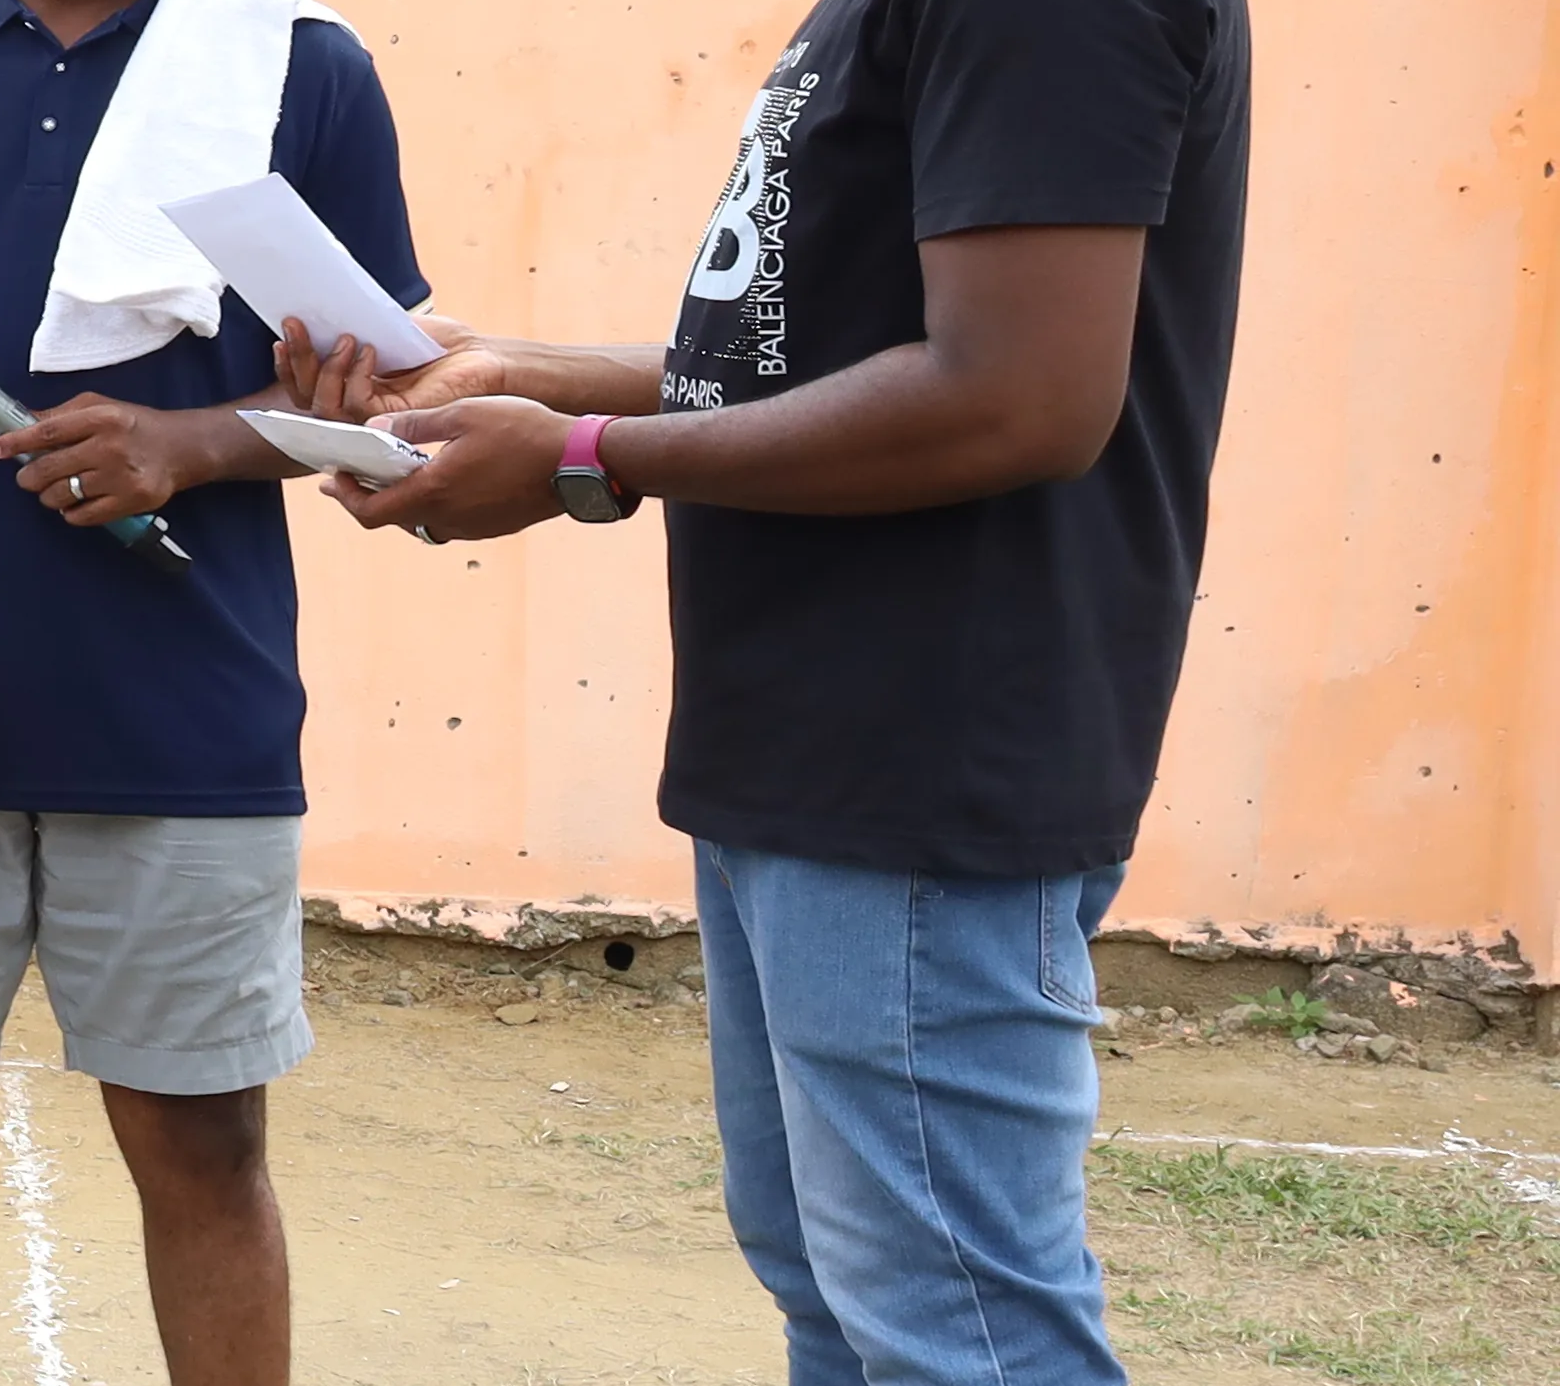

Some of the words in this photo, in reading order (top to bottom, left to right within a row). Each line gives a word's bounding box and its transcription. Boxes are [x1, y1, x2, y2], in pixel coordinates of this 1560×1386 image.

[770, 72, 820, 158] PARIS
[757, 168, 791, 376] BALENCIAGA
[677, 375, 723, 409] PARIS
